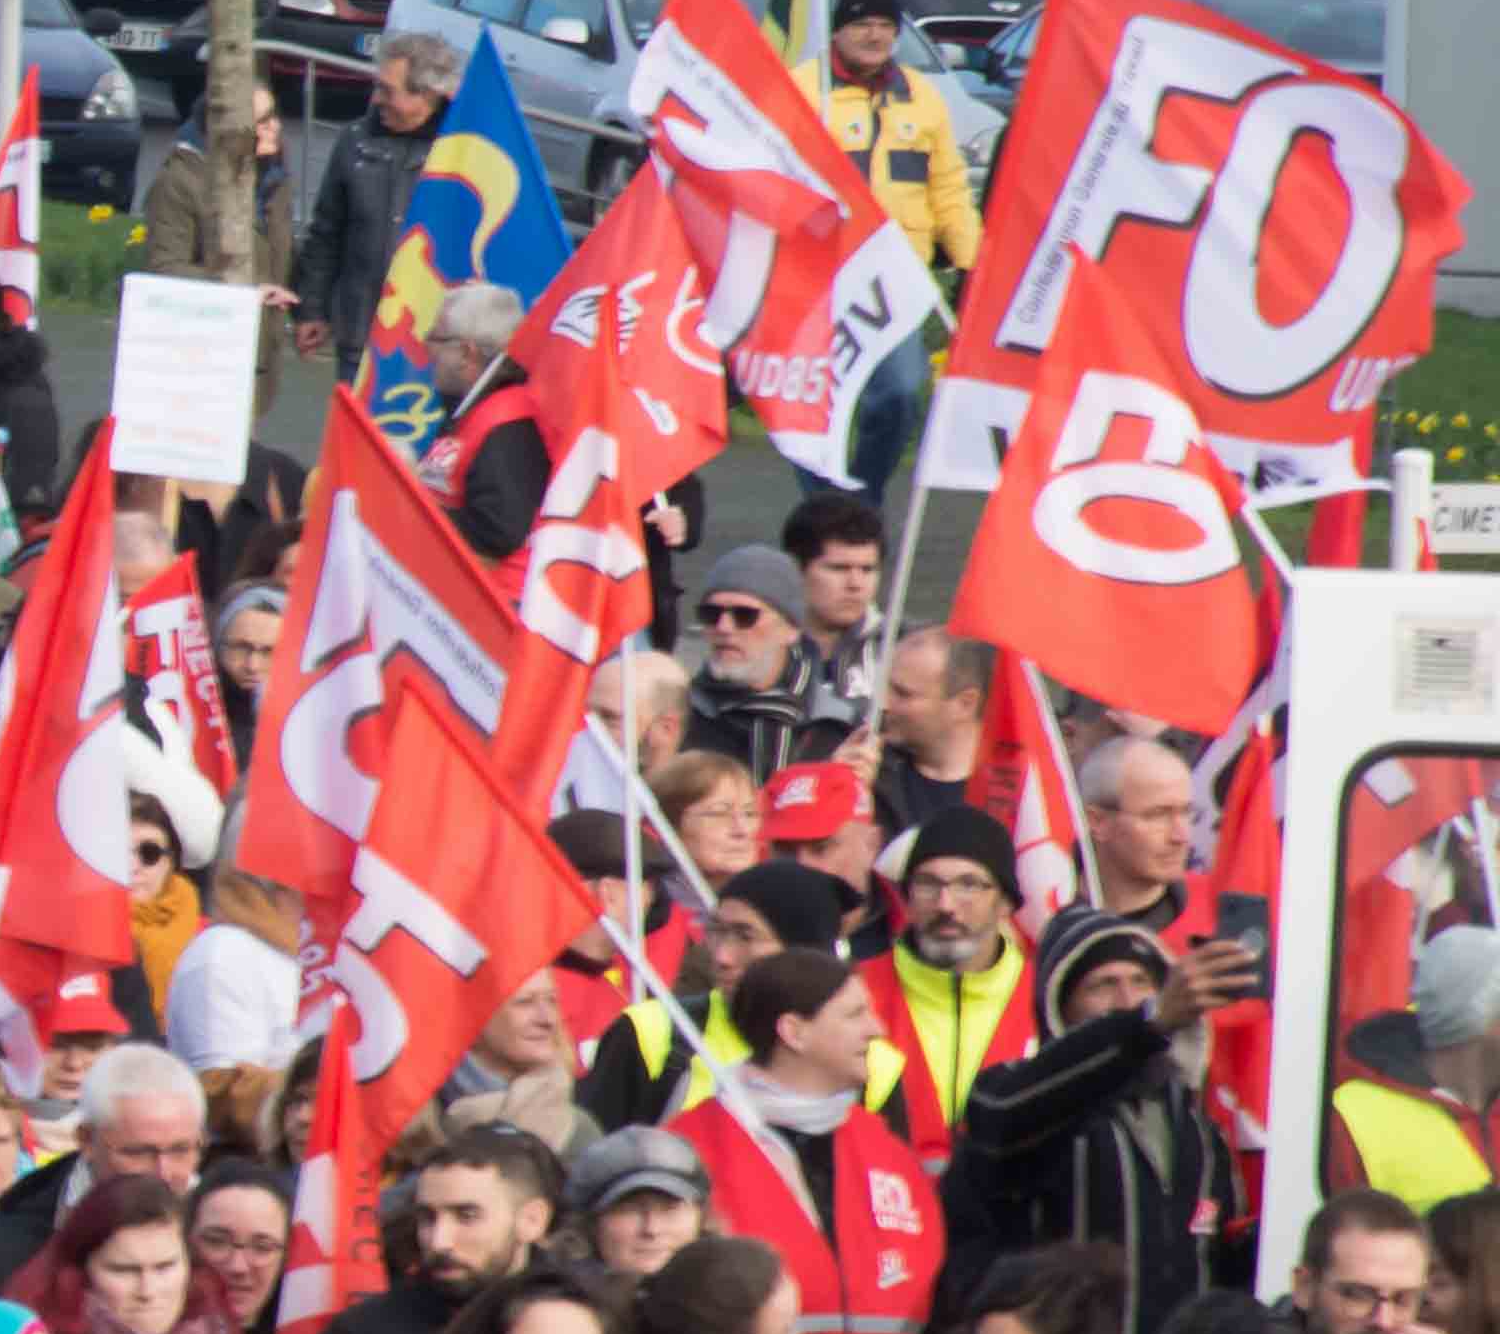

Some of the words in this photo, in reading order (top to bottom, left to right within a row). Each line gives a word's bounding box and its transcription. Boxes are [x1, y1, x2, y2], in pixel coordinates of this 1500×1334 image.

[996, 13, 1411, 402] FO
[729, 348, 827, 405] UD85
[1033, 369, 1243, 585] FO
[1434, 505, 1500, 534] CIME
